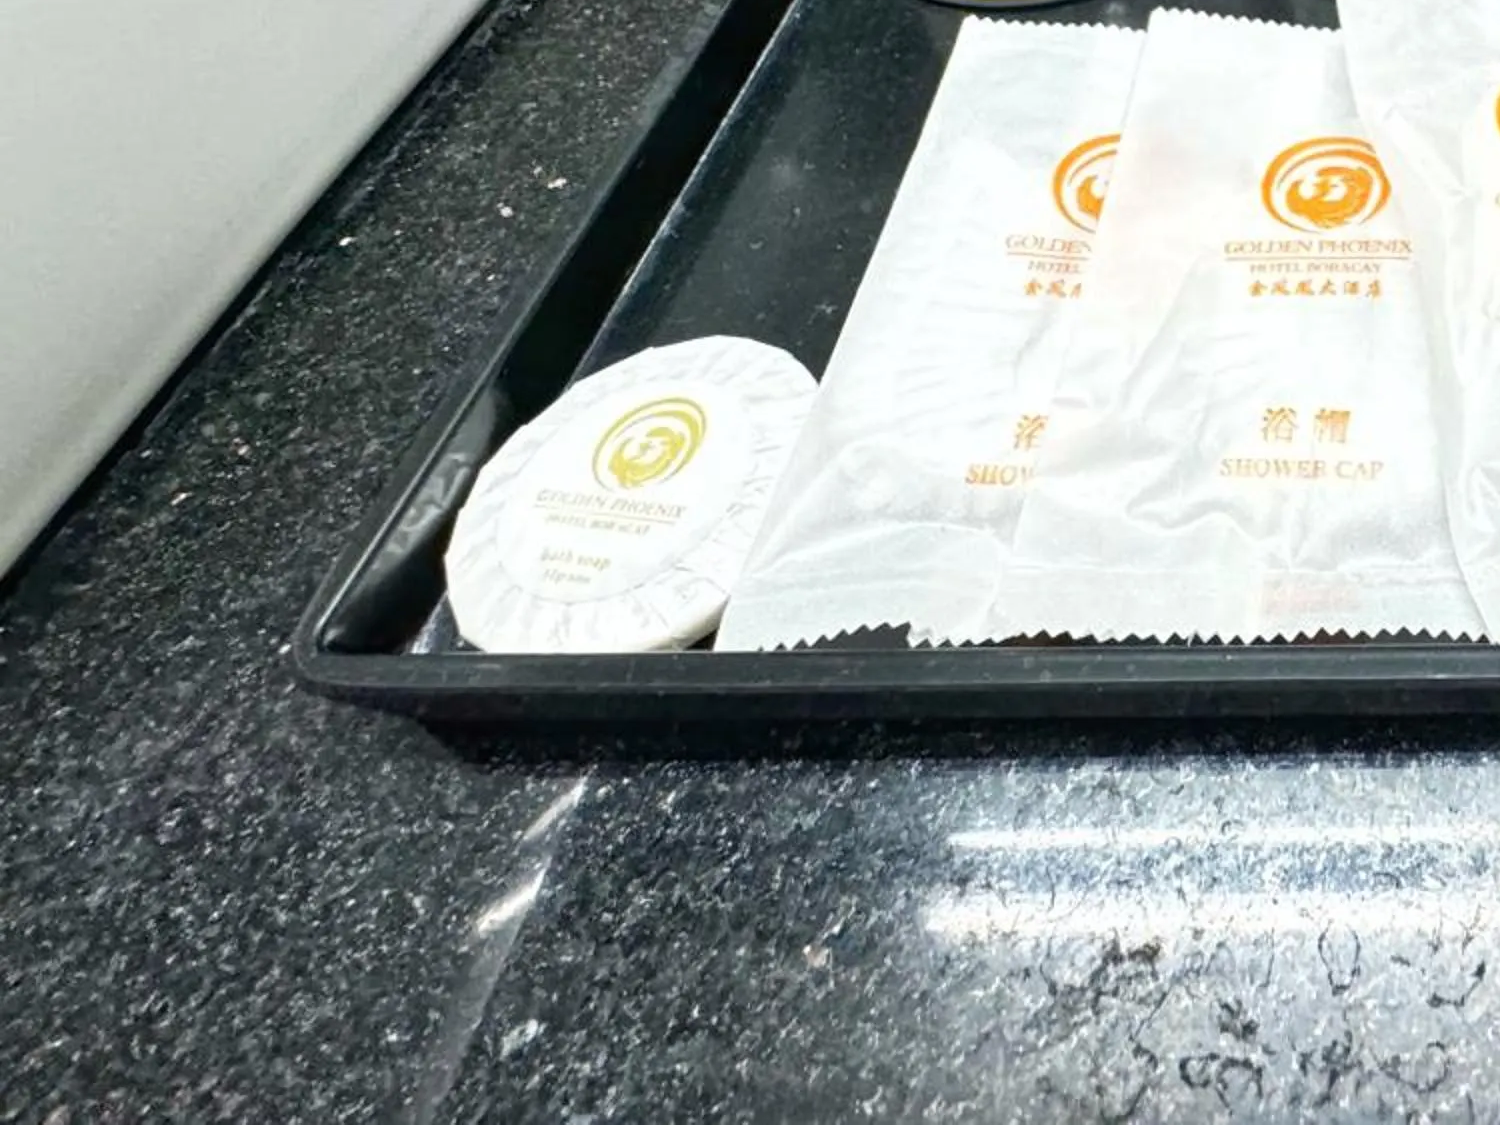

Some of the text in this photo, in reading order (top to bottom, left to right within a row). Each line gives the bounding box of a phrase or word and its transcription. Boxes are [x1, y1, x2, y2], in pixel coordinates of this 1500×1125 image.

[1224, 239, 1414, 255] GOLDEN PHOENIX
[1250, 261, 1383, 275] HOTEL BORACAY
[1261, 406, 1352, 444] 浴帽
[1220, 457, 1384, 479] SHOWER CAP
